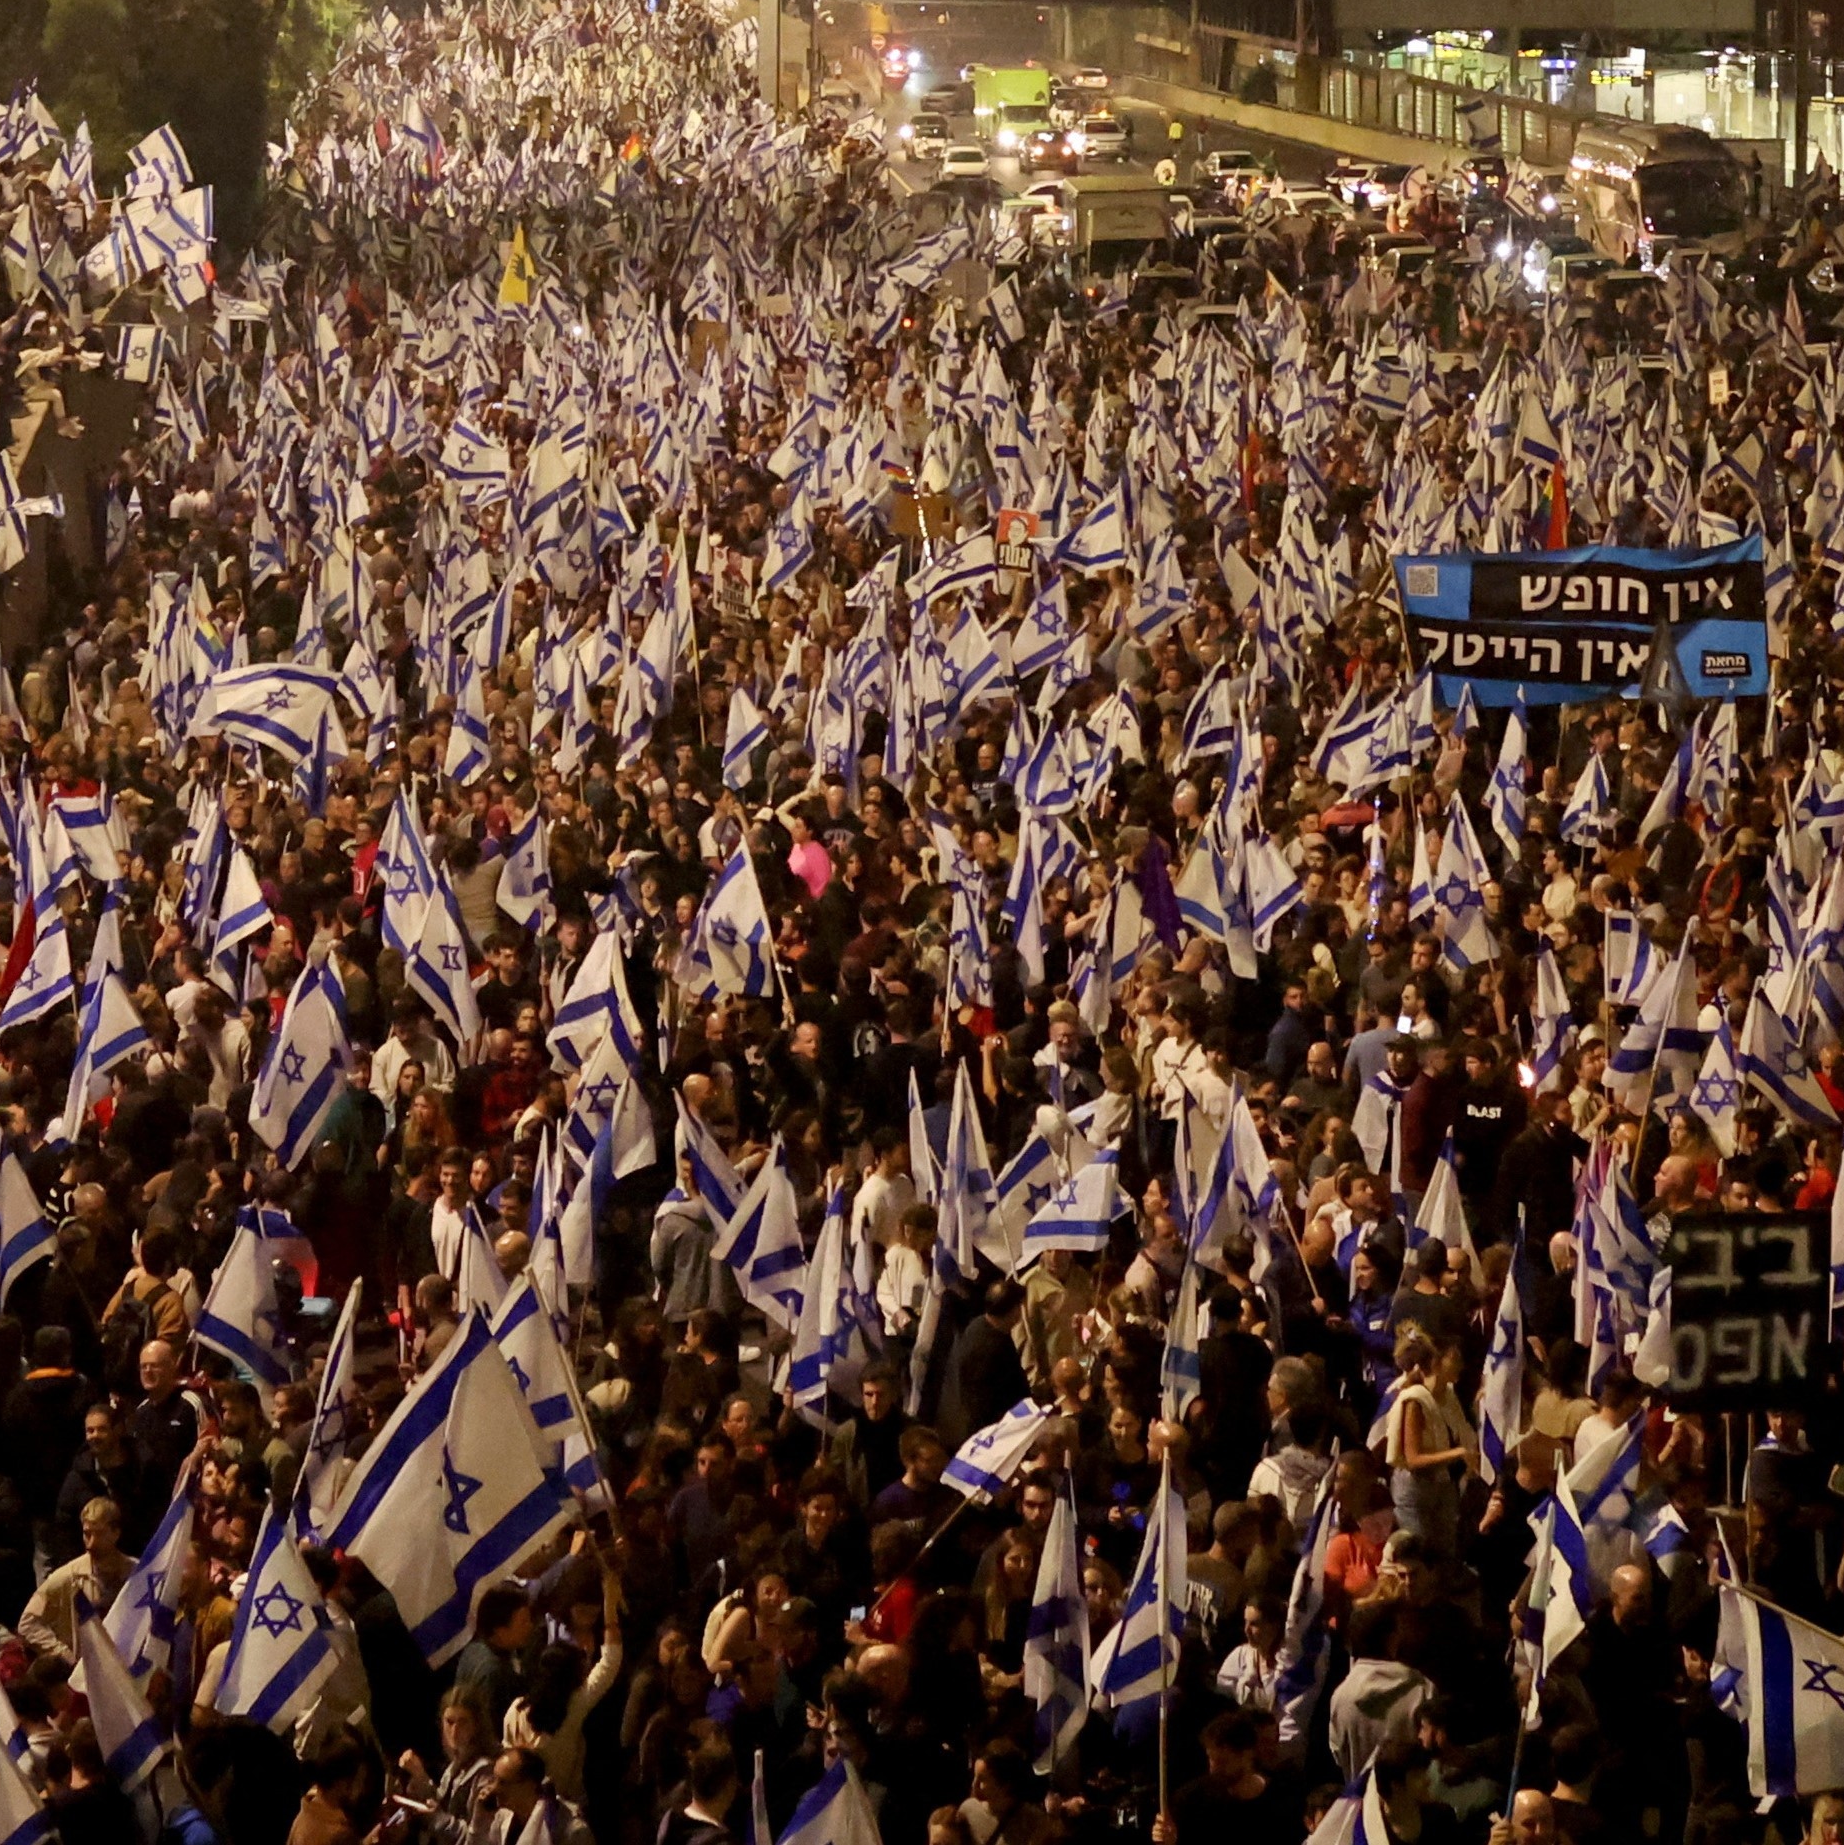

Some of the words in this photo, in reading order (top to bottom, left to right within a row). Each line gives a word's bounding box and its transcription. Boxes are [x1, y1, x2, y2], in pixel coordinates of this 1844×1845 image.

[1520, 573, 1649, 615] חופש
[1662, 576, 1734, 622] אין
[1418, 627, 1563, 675] הייטק
[1576, 638, 1650, 682] אין
[1705, 656, 1746, 667] מחאת
[1668, 1310, 1811, 1393] אפס
